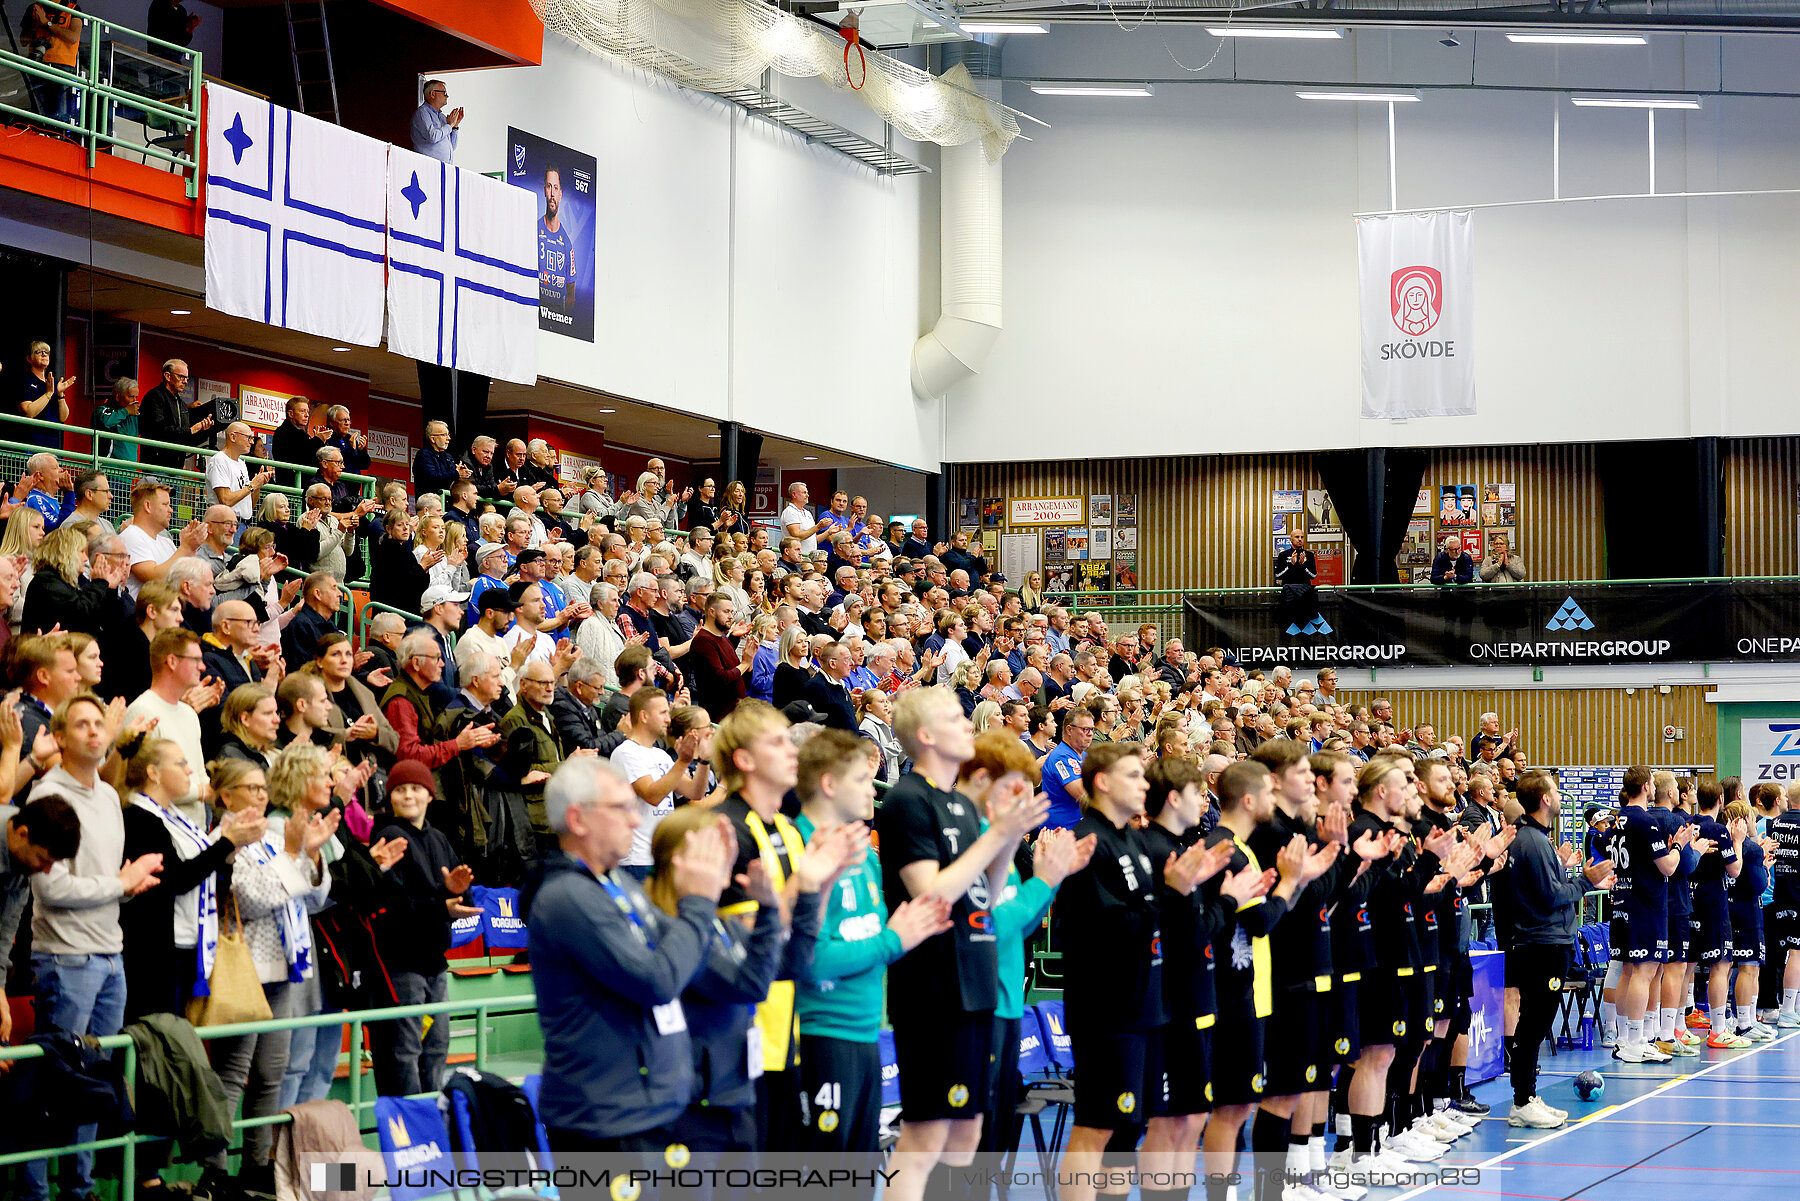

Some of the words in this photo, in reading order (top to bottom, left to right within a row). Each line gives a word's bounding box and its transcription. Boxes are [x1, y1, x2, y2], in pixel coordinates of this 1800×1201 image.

[575, 179, 589, 193] 567
[540, 287, 561, 299] VOLVO
[540, 306, 573, 325] Wremer
[1380, 340, 1455, 360] SKÖVDE
[245, 394, 287, 412] ARRANGEMA
[258, 409, 279, 423] 2002
[368, 432, 406, 449] RRANGEMANG
[376, 445, 395, 458] 2003
[756, 494, 768, 509] D
[1016, 501, 1078, 511] ARRANGEMANG
[1033, 511, 1061, 520] 2006
[1470, 640, 1670, 658] ONEPARTNERGROUP
[815, 1082, 840, 1110] 41
